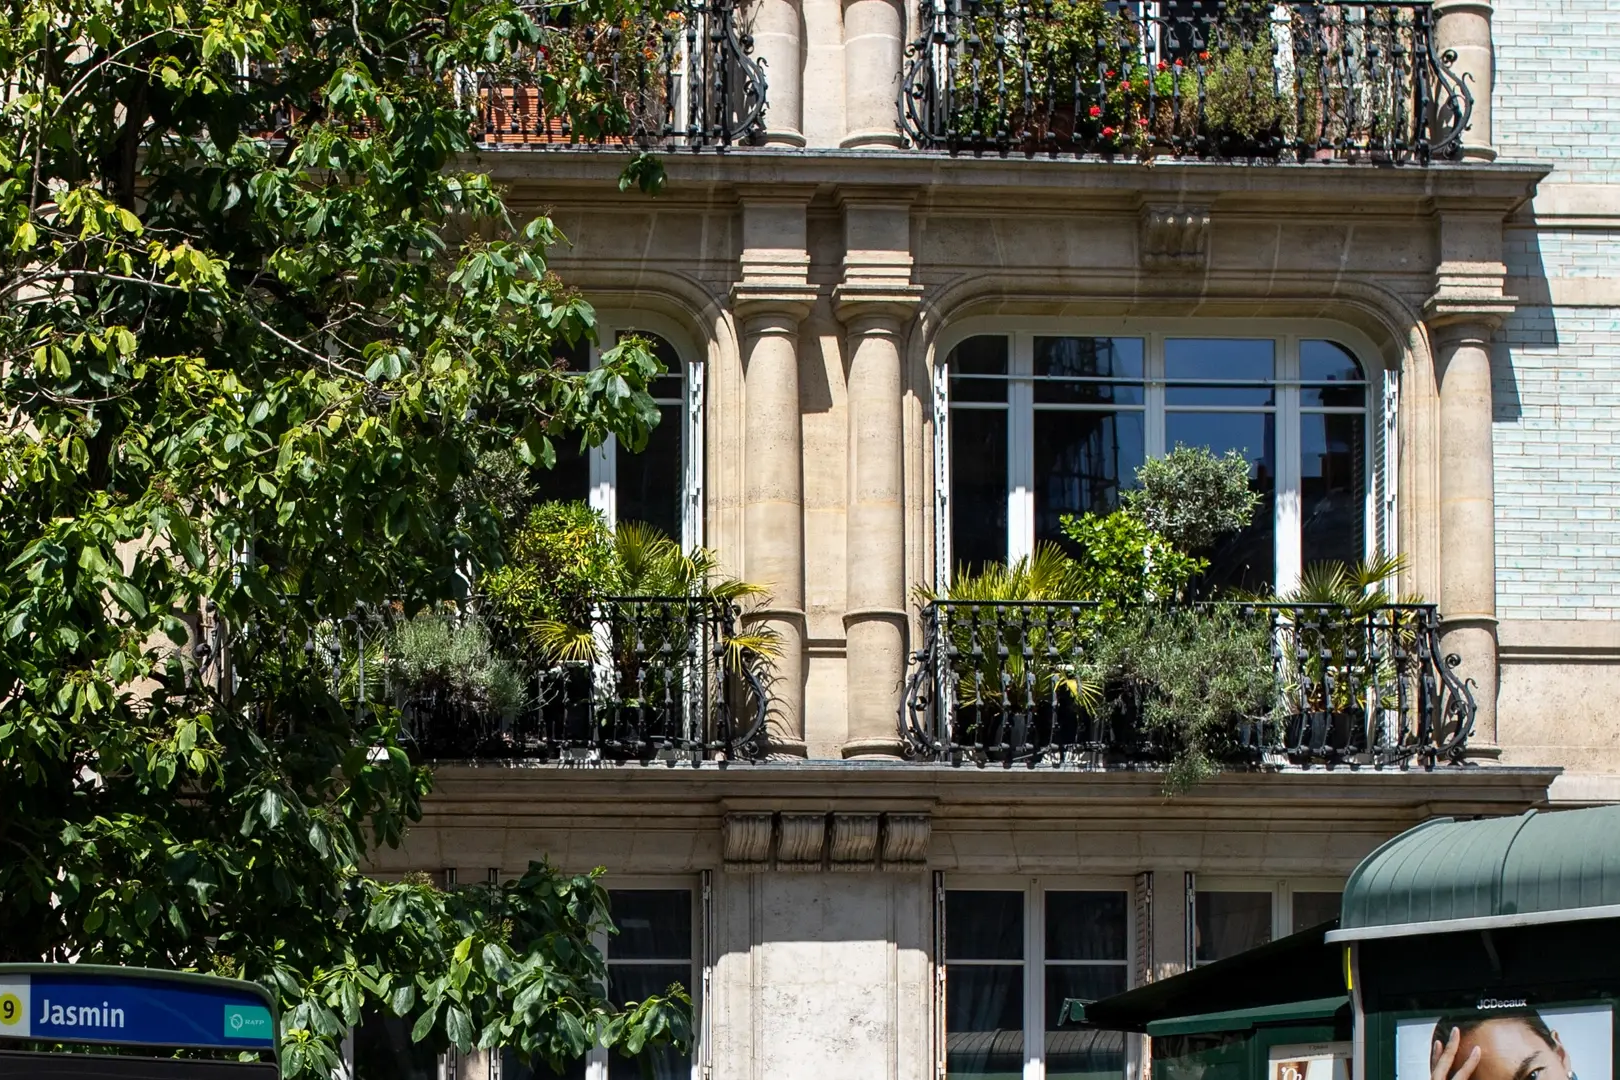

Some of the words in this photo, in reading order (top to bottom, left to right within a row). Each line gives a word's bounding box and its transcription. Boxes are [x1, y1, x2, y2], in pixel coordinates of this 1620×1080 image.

[3, 1000, 15, 1019] 9
[39, 999, 125, 1028] Jasmin
[1476, 998, 1527, 1010] JCDecaux
